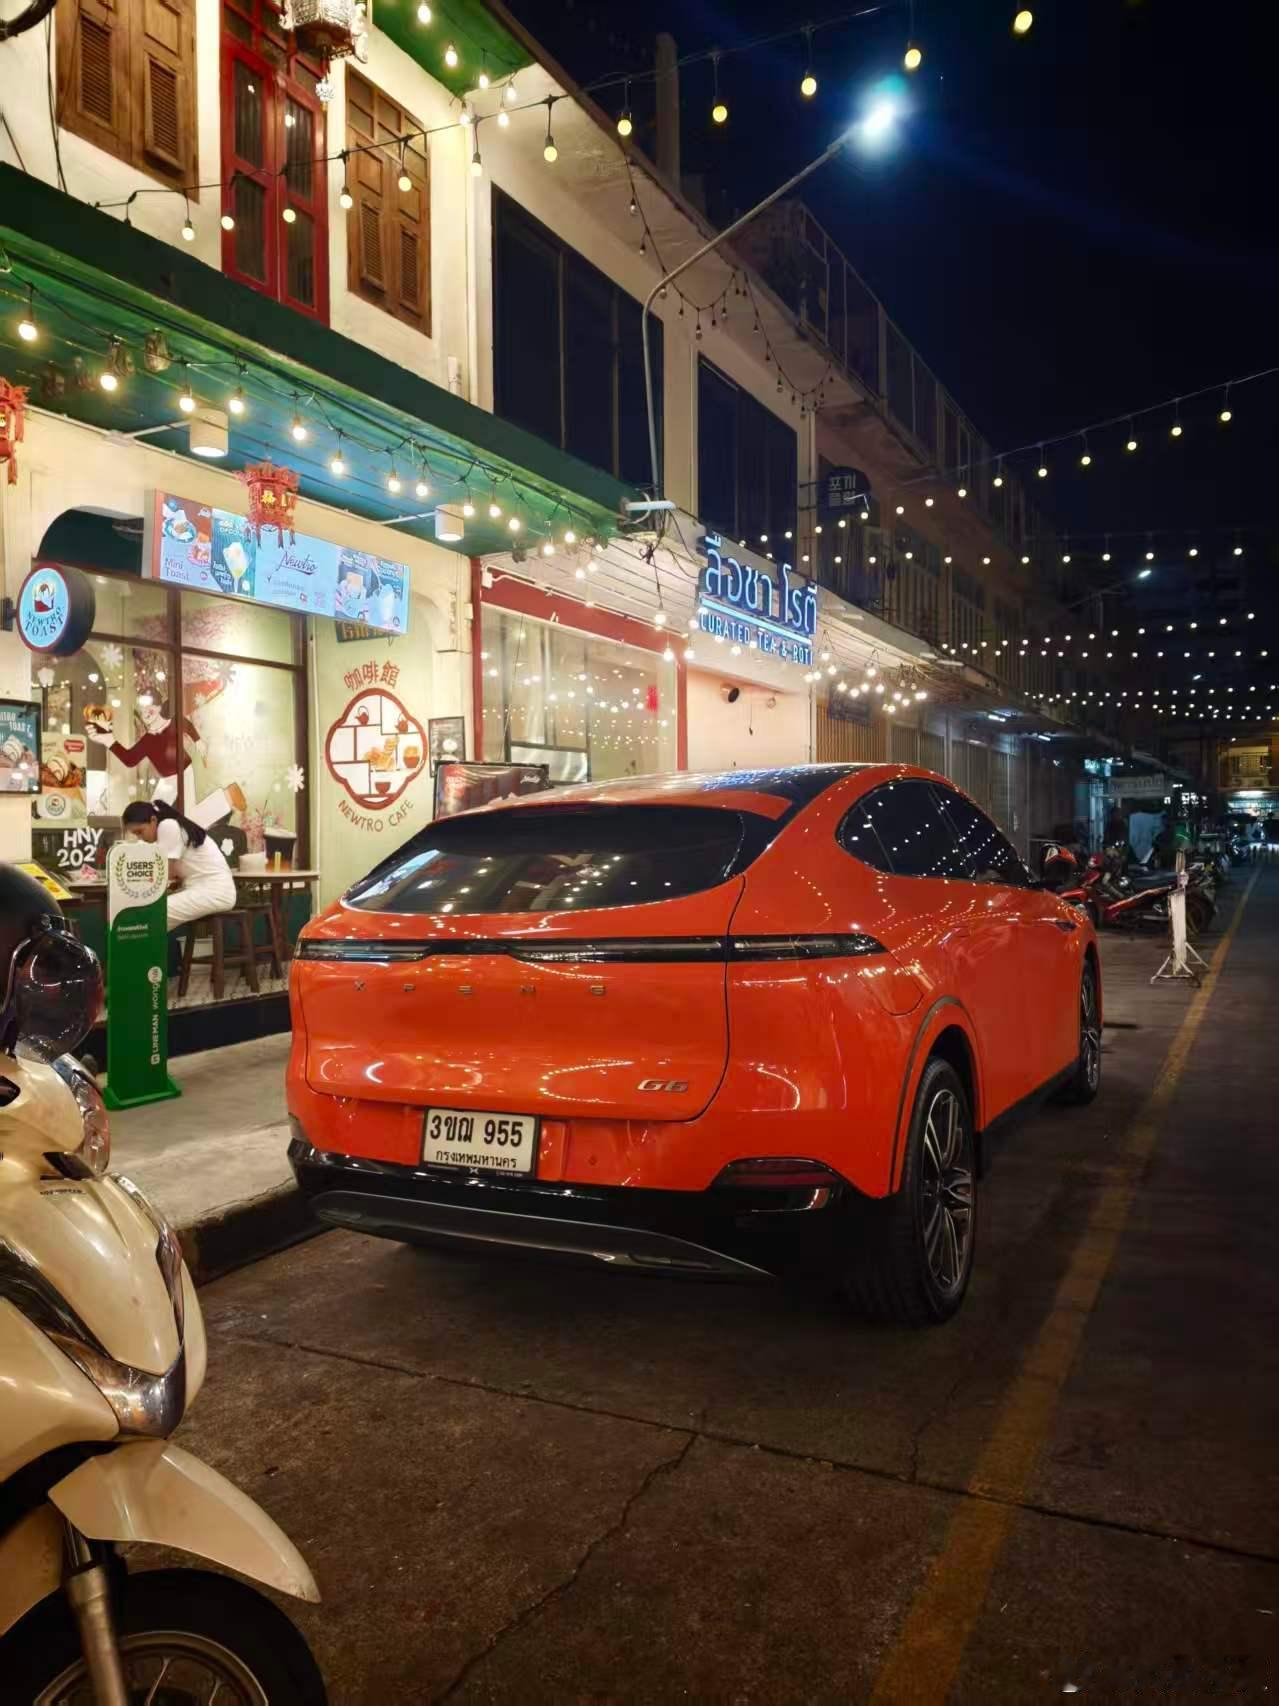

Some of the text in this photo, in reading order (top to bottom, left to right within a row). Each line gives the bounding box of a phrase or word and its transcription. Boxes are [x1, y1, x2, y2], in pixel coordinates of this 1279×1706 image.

[165, 557, 183, 569] Mini
[166, 567, 189, 581] Toast
[276, 551, 318, 575] Newtro
[25, 615, 64, 637] TOAST
[28, 606, 62, 625] NEWTRO
[700, 612, 813, 665] CURATED TEA & ROTI
[344, 660, 400, 691] 咖啡館
[338, 800, 414, 832] NEWTRO CAFE
[63, 826, 104, 848] HNY
[57, 845, 105, 867] 202
[127, 870, 154, 878] CHOICE
[637, 1079, 688, 1092] G6
[484, 1119, 523, 1147] 955
